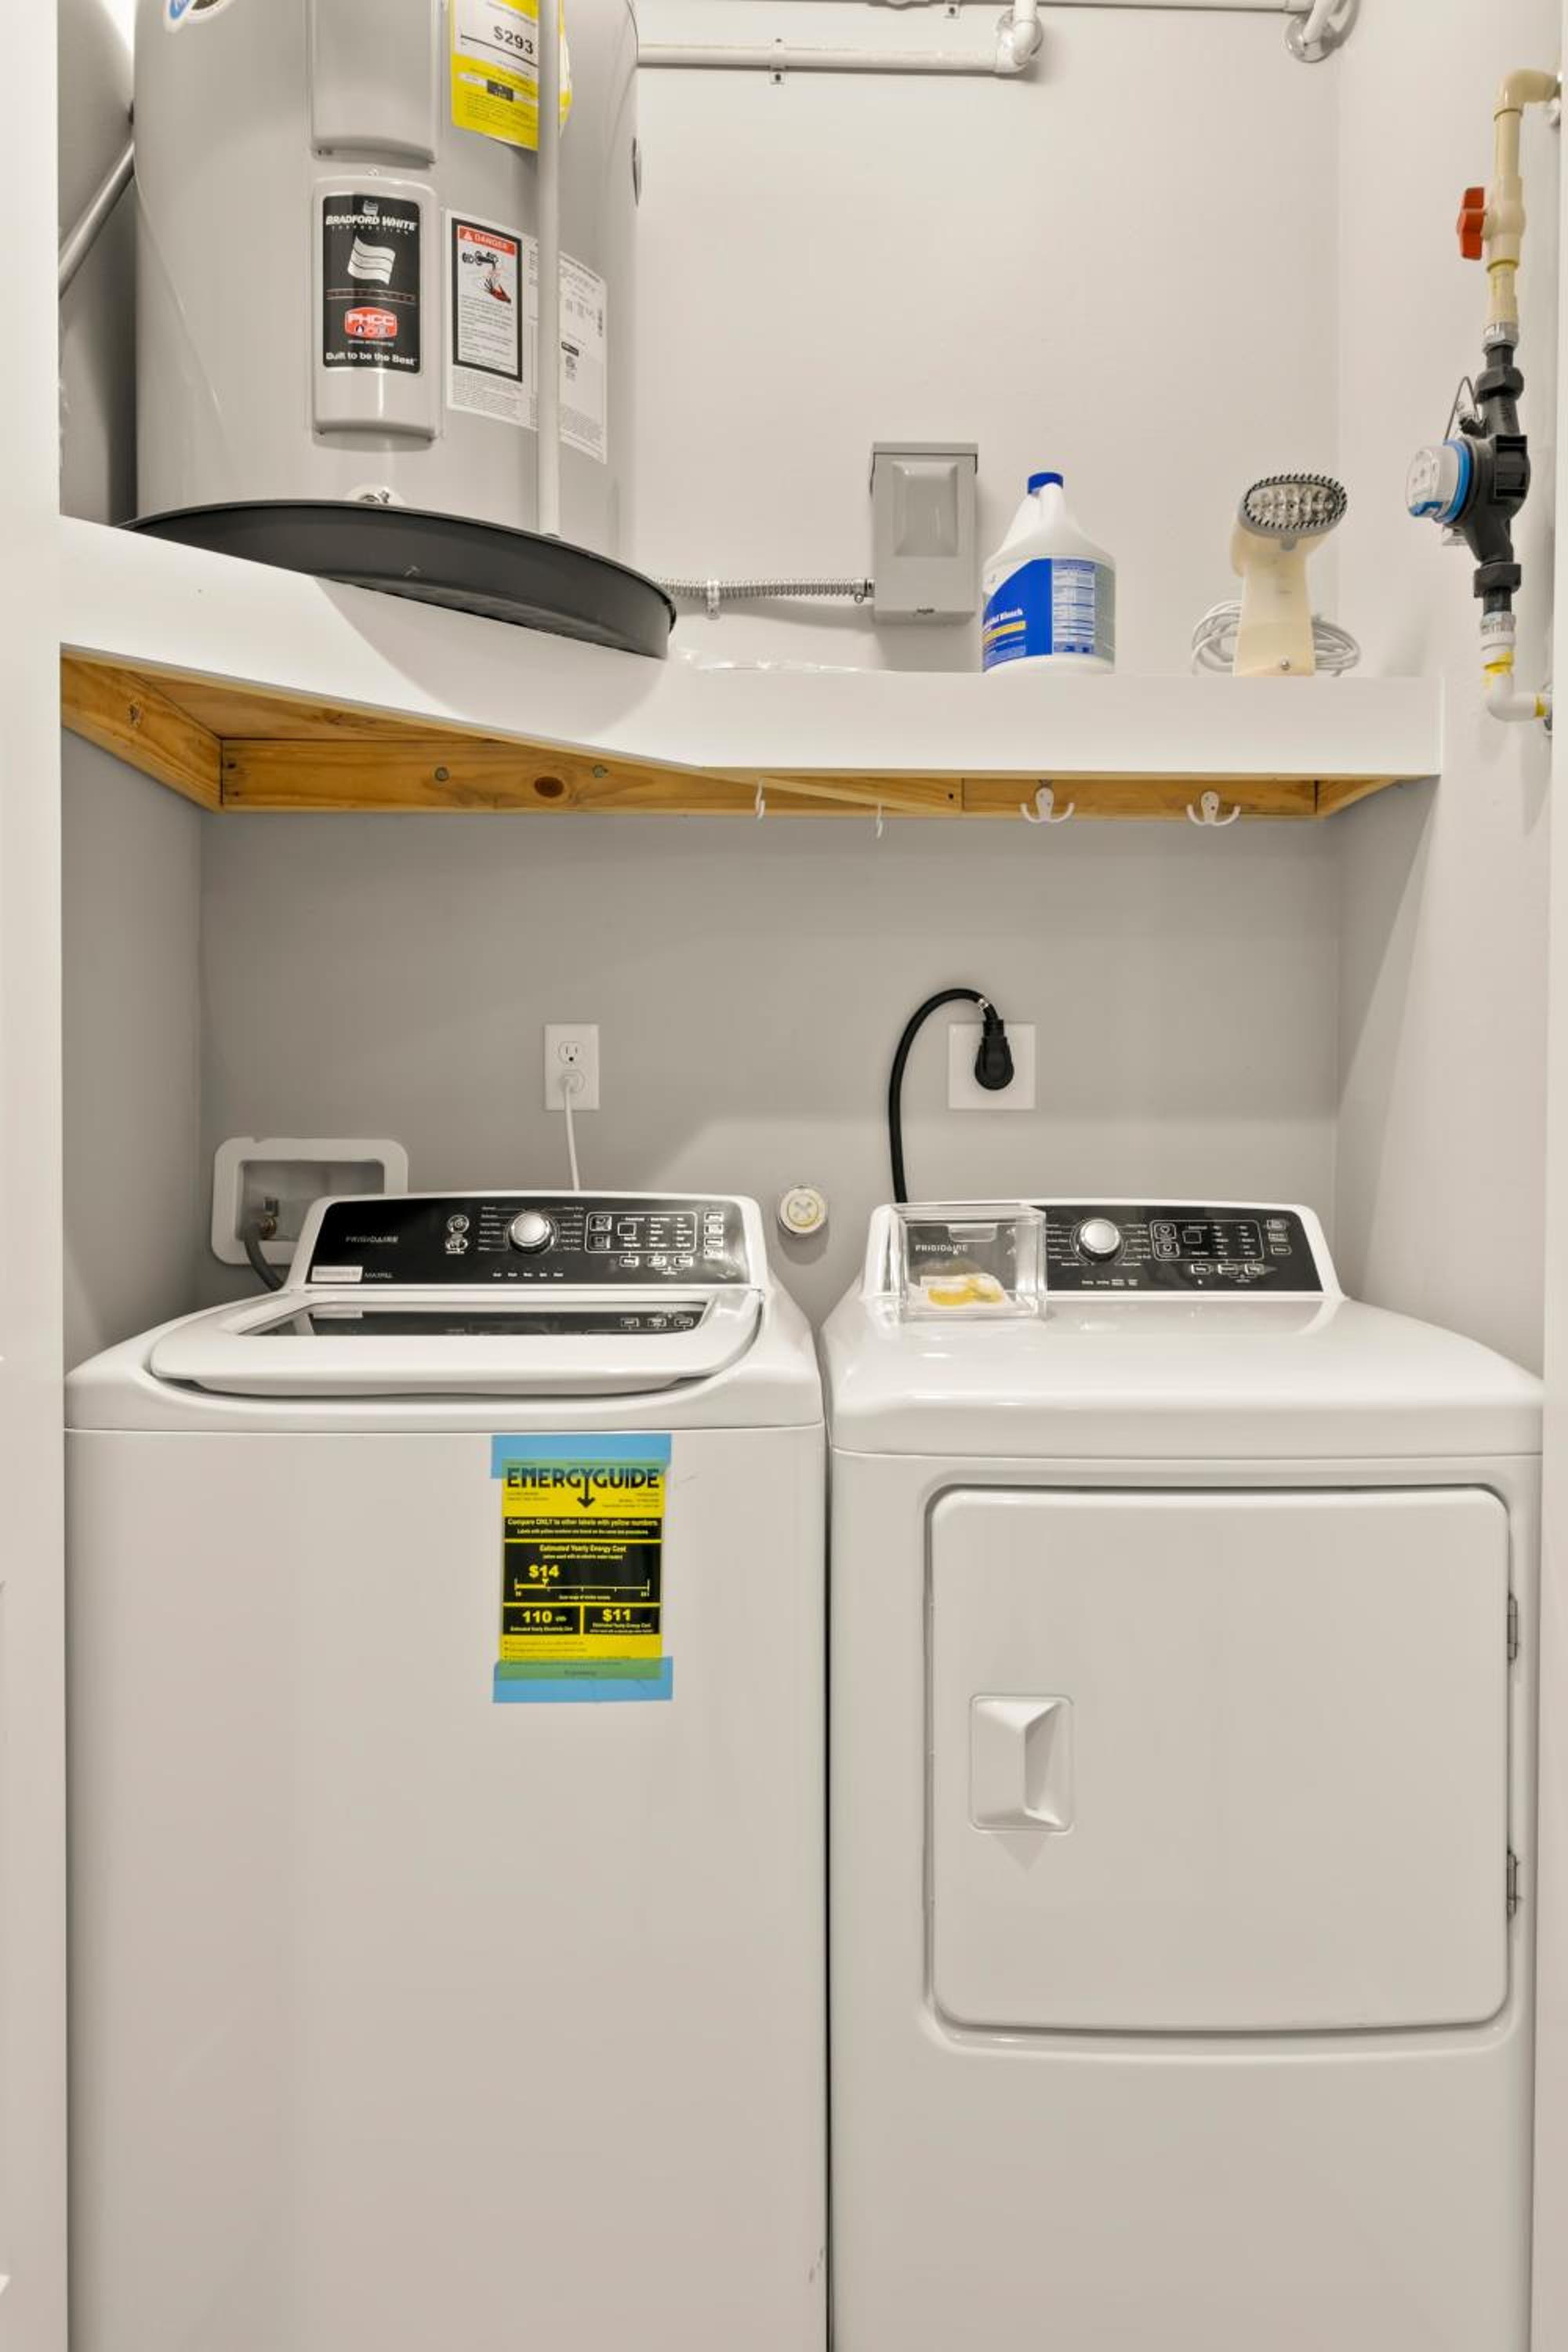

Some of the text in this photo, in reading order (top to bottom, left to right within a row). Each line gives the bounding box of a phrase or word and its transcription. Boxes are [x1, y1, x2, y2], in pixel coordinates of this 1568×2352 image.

[493, 25, 534, 55] $293
[326, 214, 417, 231] BRADFORD WHITE
[474, 233, 508, 249] DANGER
[347, 314, 394, 325] PHCC
[374, 353, 390, 361] the
[392, 354, 415, 366] Best
[507, 1467, 659, 1489] ENERGYGUIDE
[507, 1519, 535, 1527] Compare
[539, 1544, 569, 1552] Estimated
[528, 1564, 559, 1578] $14
[522, 1610, 553, 1624] 110
[602, 1608, 631, 1622] $11
